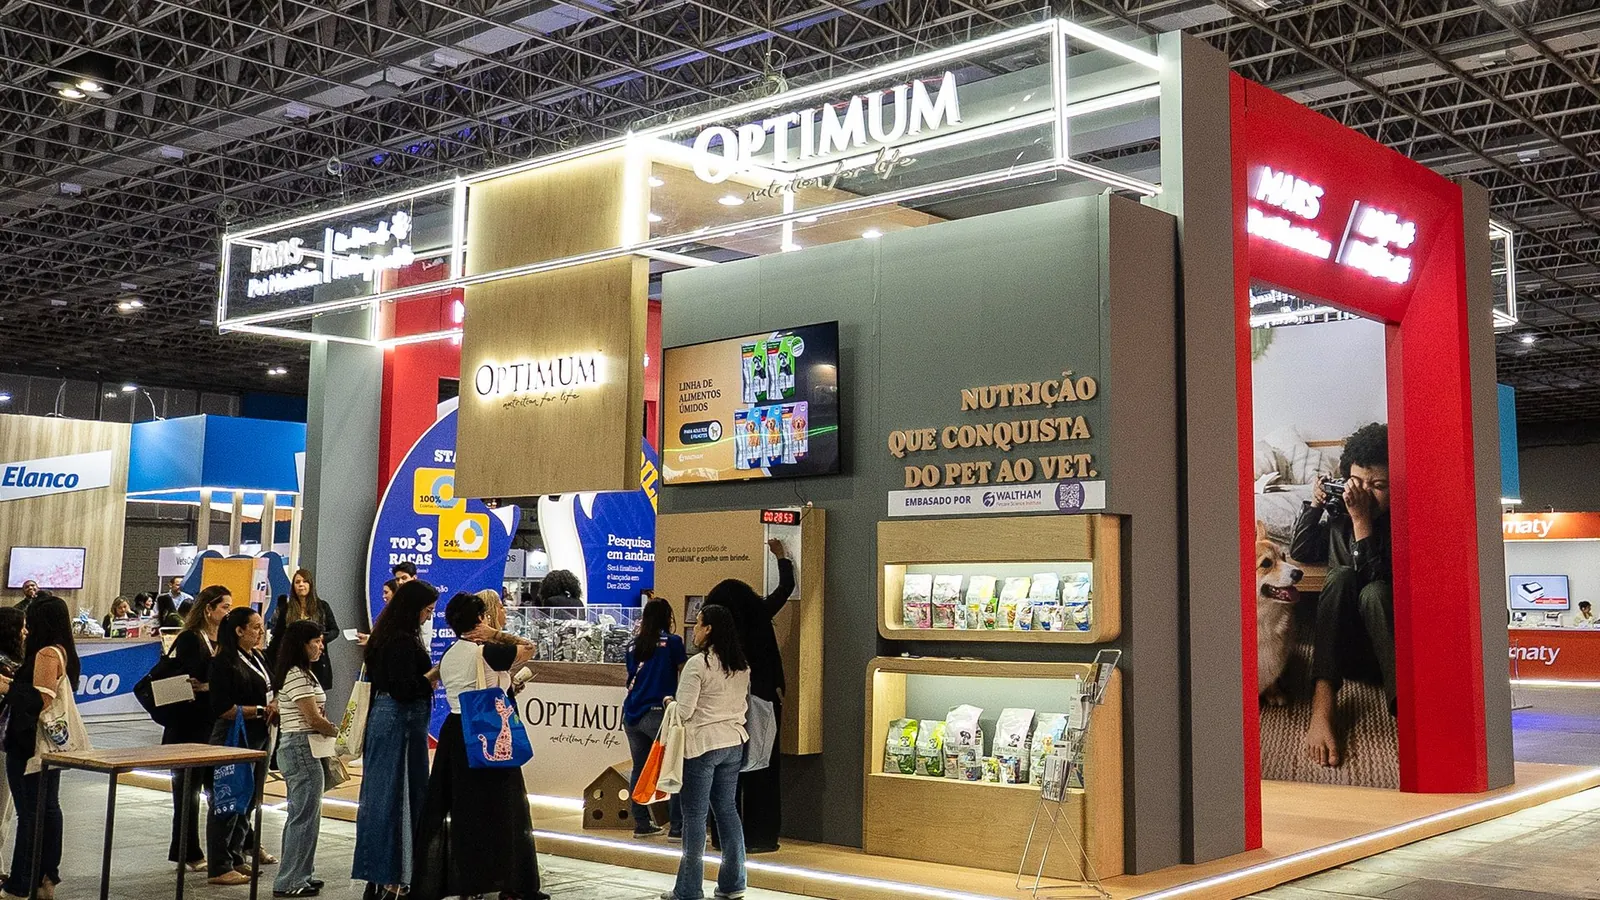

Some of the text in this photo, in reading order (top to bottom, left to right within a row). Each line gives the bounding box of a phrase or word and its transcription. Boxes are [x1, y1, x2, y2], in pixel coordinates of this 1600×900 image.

[692, 71, 961, 183] OPTIMUM
[747, 147, 916, 201] nutrition for life
[1256, 166, 1325, 219] MARS
[251, 237, 303, 273] MARS
[475, 356, 596, 395] OPTIMUM
[679, 379, 713, 391] LINHA DE
[960, 370, 1098, 411] NUTRIÇÃO
[503, 389, 579, 409] nutrition for life
[679, 389, 721, 402] ALIMENTOS
[679, 402, 708, 413] ÚMIDOS
[888, 415, 1091, 459] QUE CONQUISTA
[434, 449, 456, 463] ST
[2, 467, 79, 489] Elanco
[904, 453, 1098, 488] DO PET AO VET.
[420, 495, 441, 503] 100%
[905, 495, 972, 507] EMBASADO POR
[996, 490, 1042, 500] WALTHAM
[389, 527, 433, 552] TOP 3
[607, 534, 652, 549] Pesquisa
[607, 550, 623, 560] em
[697, 545, 719, 554] portfólio
[701, 555, 718, 564] ganhe
[620, 564, 643, 573] finalizada
[617, 582, 631, 590] 2025
[549, 732, 621, 748] nutrition for life
